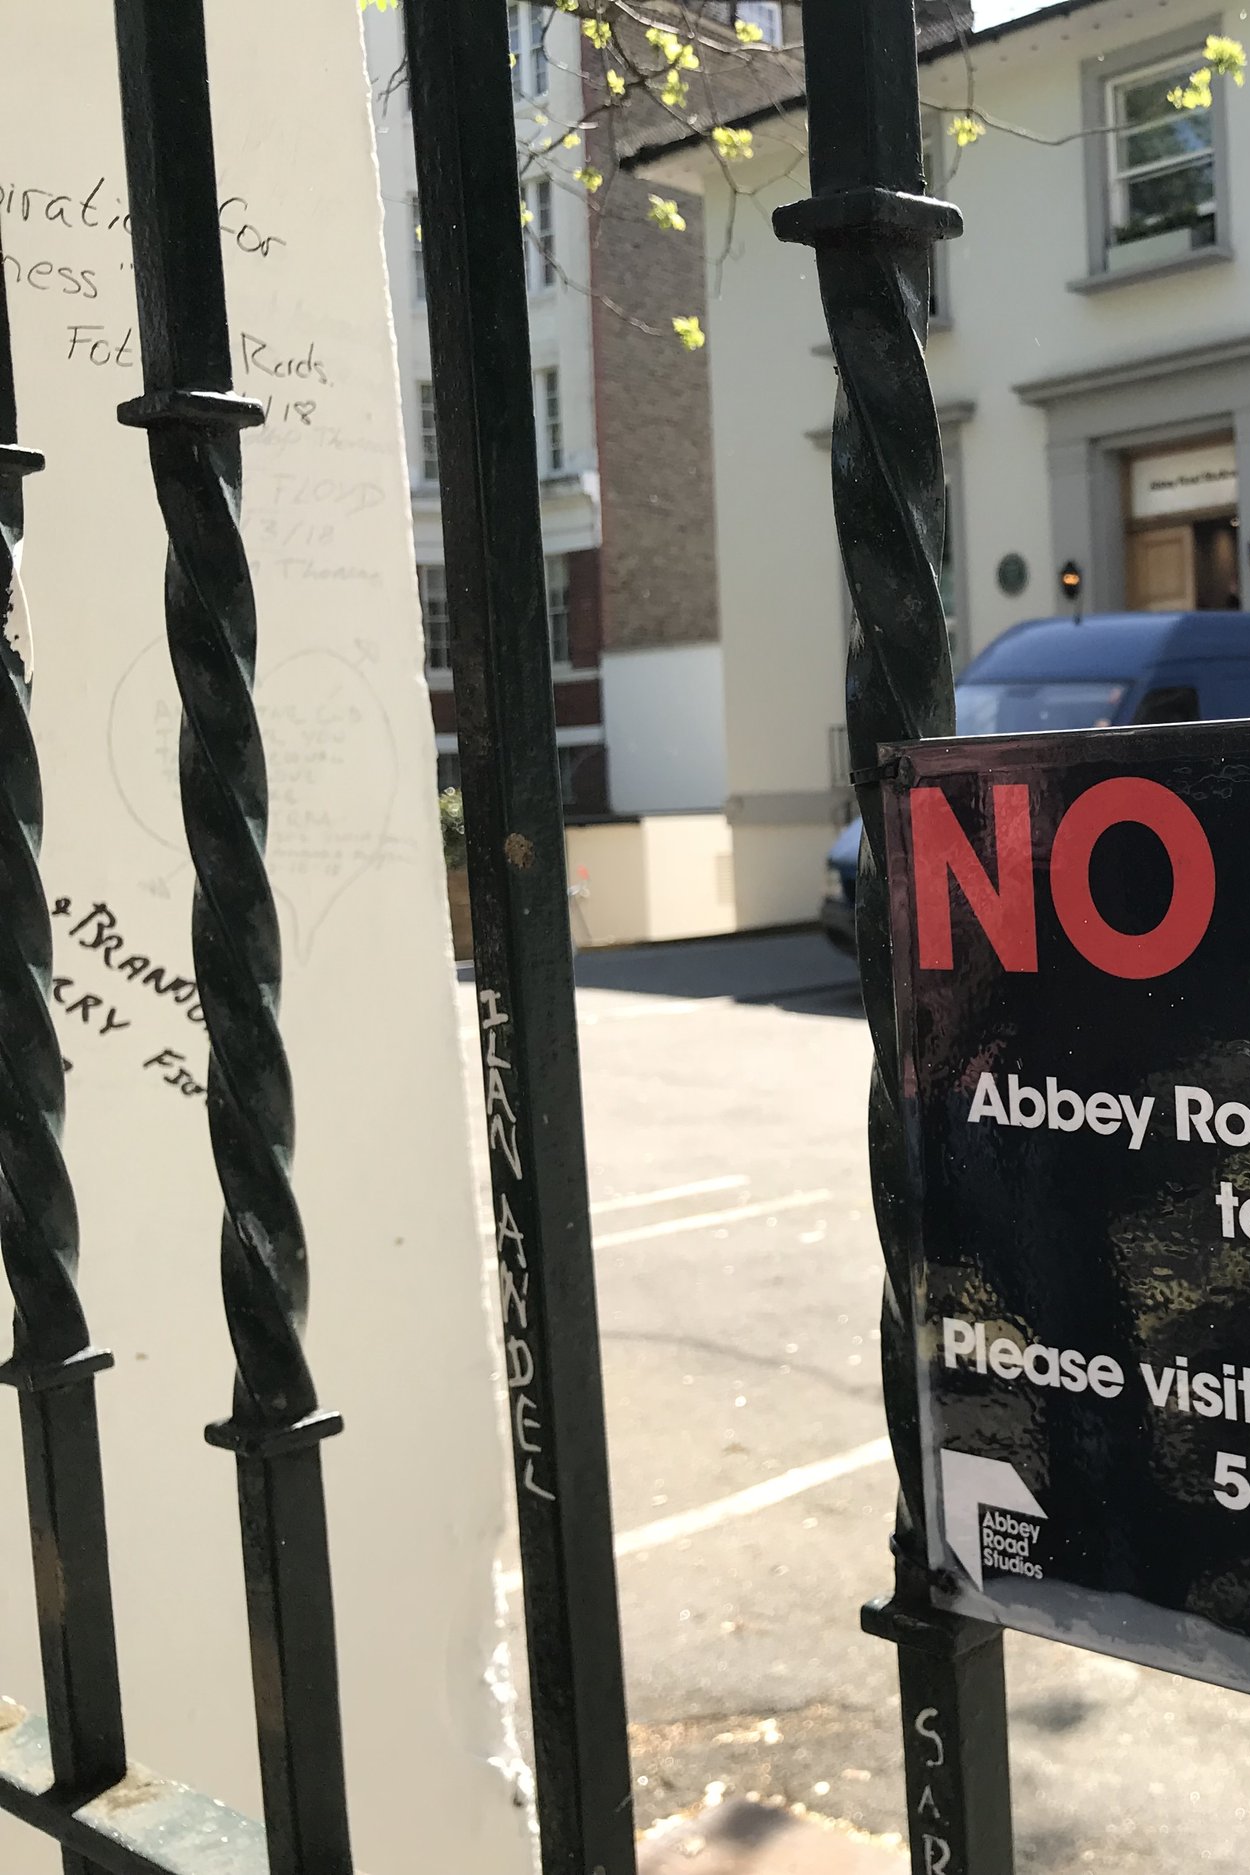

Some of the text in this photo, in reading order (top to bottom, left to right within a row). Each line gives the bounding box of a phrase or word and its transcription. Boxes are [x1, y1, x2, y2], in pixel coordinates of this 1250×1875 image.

[909, 777, 1215, 980] NO
[968, 1072, 1155, 1149] Abbey
[943, 1318, 1124, 1398] Please
[982, 1510, 1040, 1544] Abbey
[982, 1527, 1030, 1557] Road
[983, 1548, 1044, 1580] Studios
